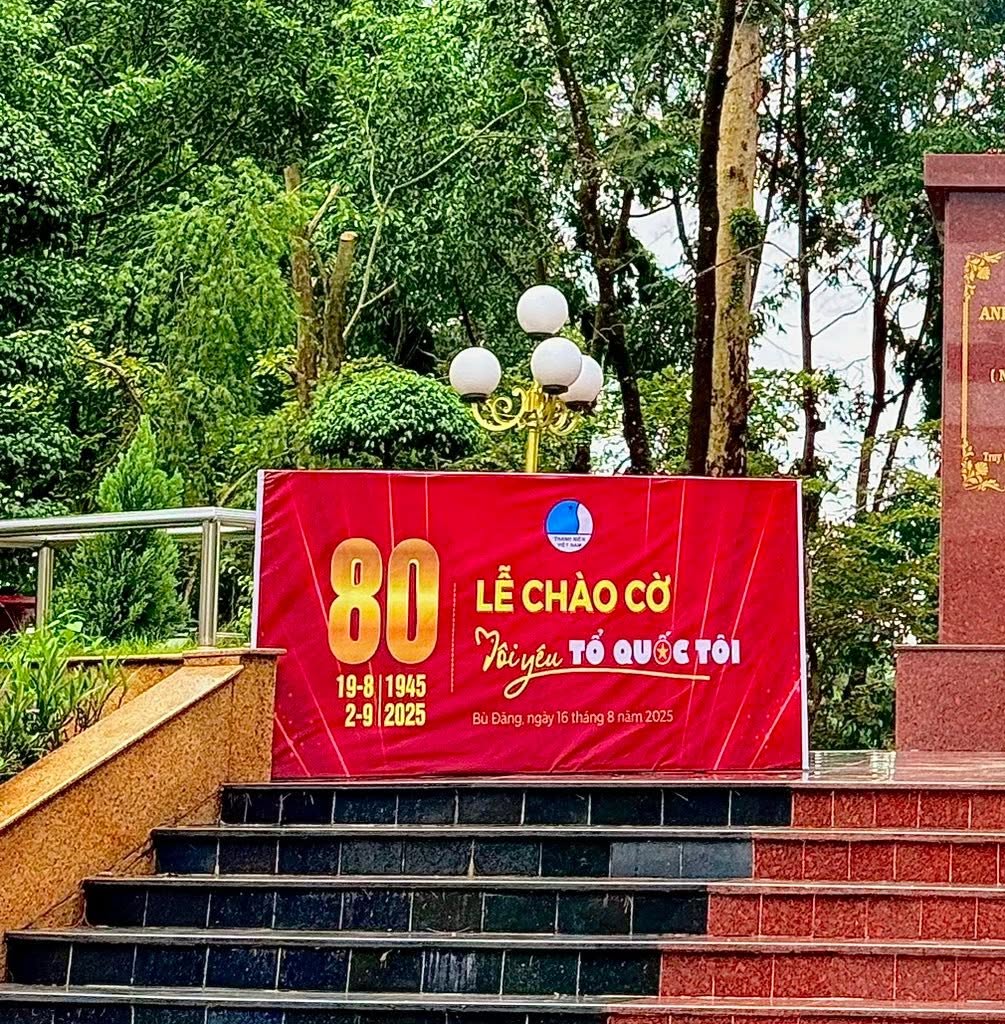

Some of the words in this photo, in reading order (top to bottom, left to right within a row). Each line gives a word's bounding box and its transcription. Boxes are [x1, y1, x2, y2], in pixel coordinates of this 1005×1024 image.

[983, 452, 1002, 464] Truy
[328, 538, 440, 664] 80
[476, 565, 514, 612] LỄ
[522, 571, 618, 613] CHÀO
[624, 571, 671, 613] CỜ
[504, 644, 563, 699] yêu
[569, 629, 605, 665] TỔ
[613, 631, 689, 665] QUỐC
[695, 634, 740, 664] TÔI
[336, 674, 374, 698] 19-8
[385, 674, 427, 698] 1945
[344, 703, 373, 727] 2-9
[384, 703, 426, 726] 2025
[473, 710, 488, 724] Bù
[491, 711, 524, 727] Đăng,
[528, 713, 554, 727] ngày
[557, 711, 568, 723] 16
[572, 710, 604, 726] tháng
[607, 711, 615, 723] 8
[618, 710, 643, 723] năm
[645, 710, 674, 723] 2025
